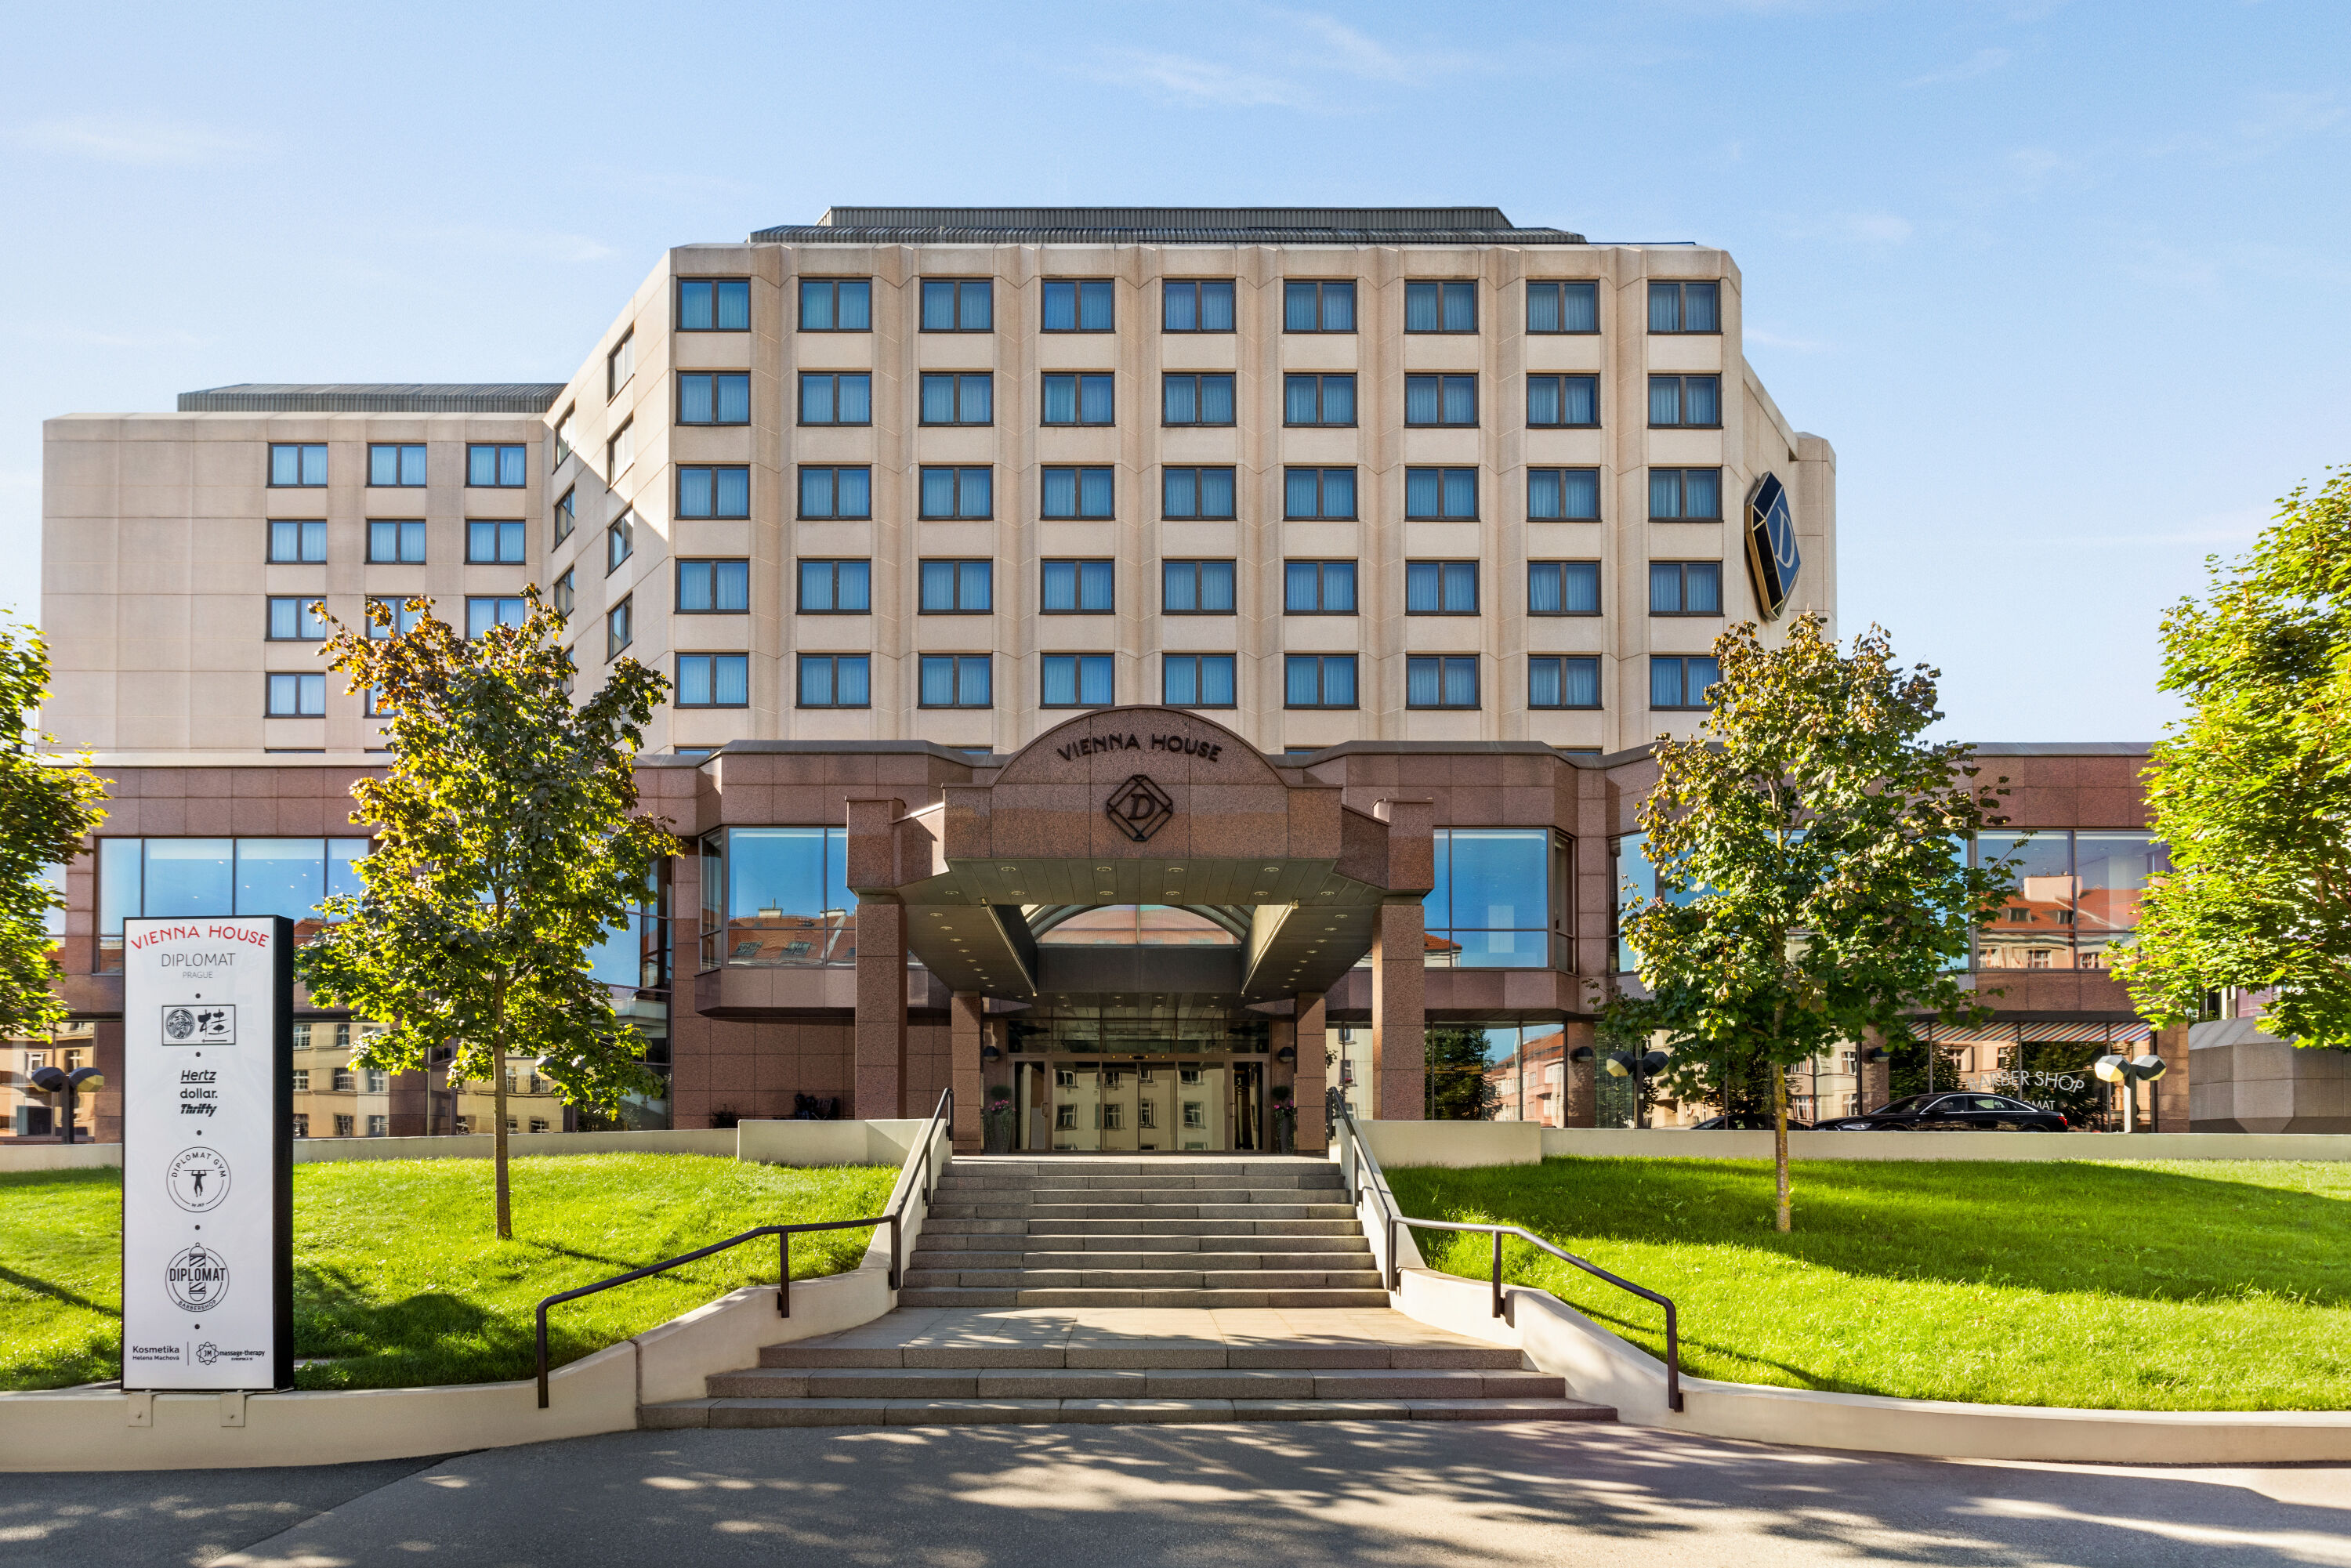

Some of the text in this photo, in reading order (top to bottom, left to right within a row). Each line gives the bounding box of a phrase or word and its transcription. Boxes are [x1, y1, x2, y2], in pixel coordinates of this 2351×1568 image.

[1057, 733, 1223, 762] VIENNA HOUSE
[1127, 793, 1156, 820] D
[131, 925, 270, 950] VIENNA HOUSE
[161, 953, 236, 967] DIPLOMAT
[180, 1069, 217, 1081] Hertz
[1966, 1070, 2085, 1093] BARBER SHOP
[179, 1088, 219, 1099] dollar.
[180, 1103, 218, 1117] Thrifty
[171, 1152, 226, 1178] DIPLOMAT GYM
[169, 1267, 226, 1282] DIPLOMAT
[178, 1299, 217, 1311] BARBERSHOP
[219, 1348, 265, 1357] massage-therapy
